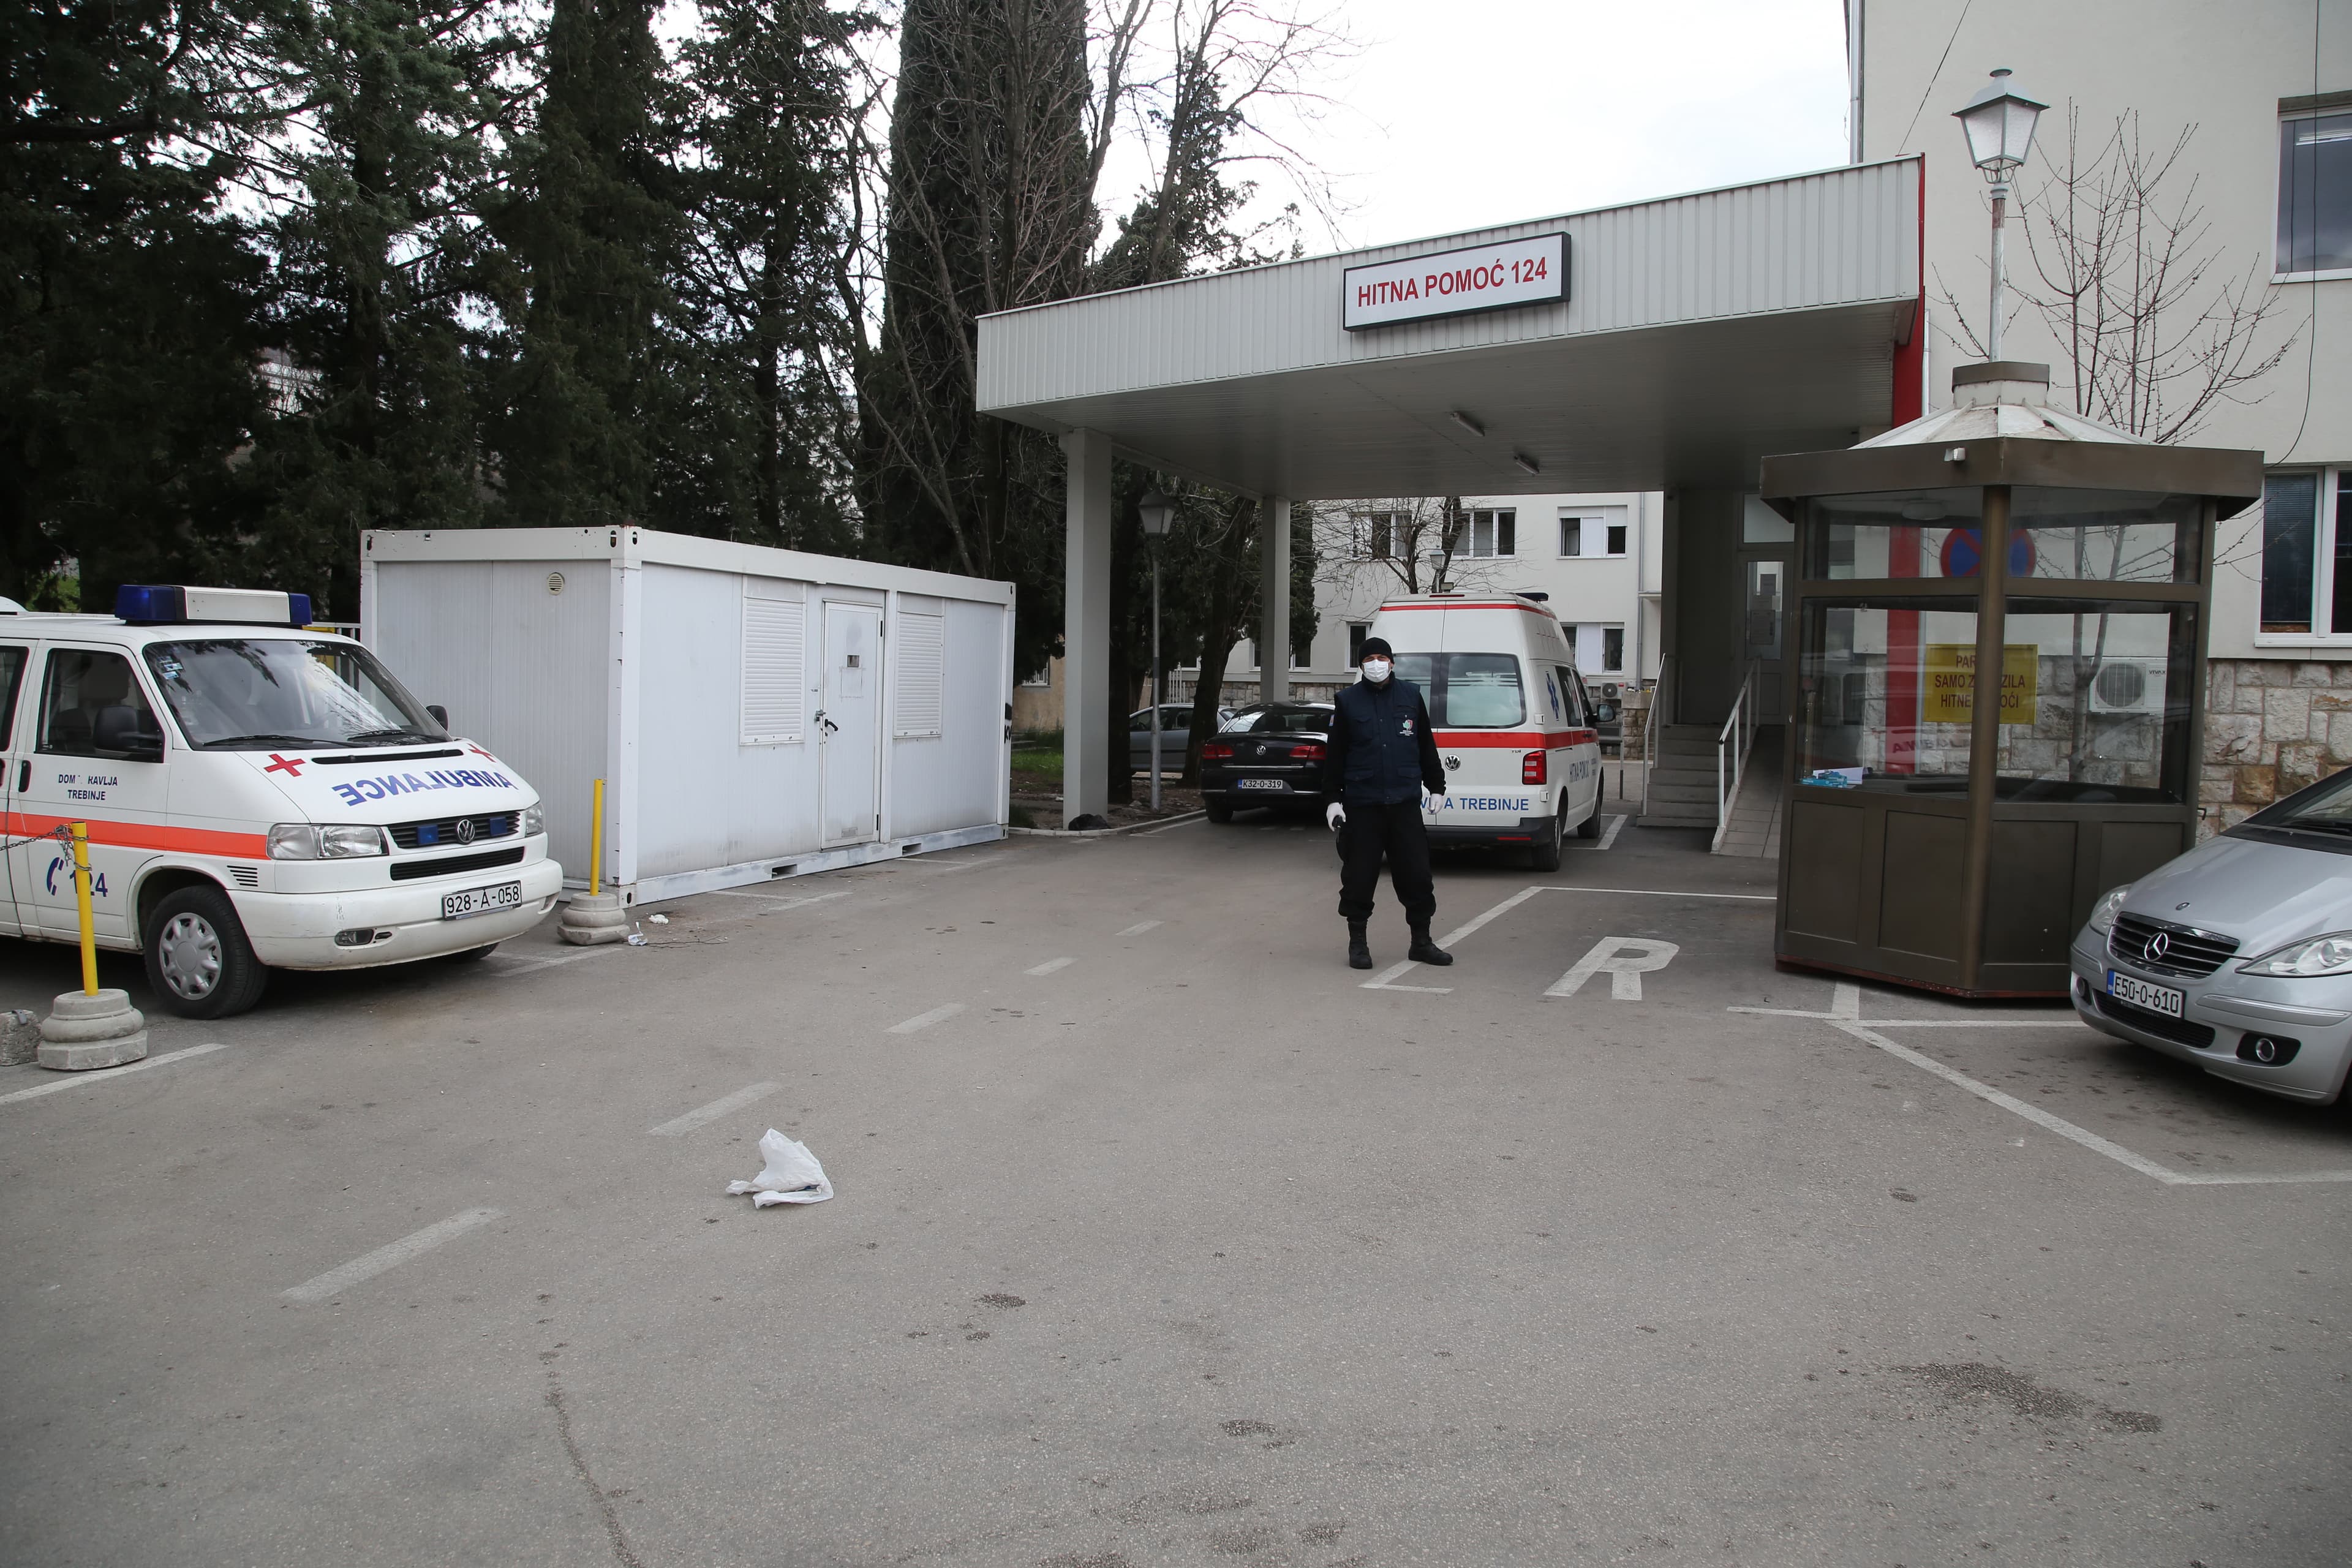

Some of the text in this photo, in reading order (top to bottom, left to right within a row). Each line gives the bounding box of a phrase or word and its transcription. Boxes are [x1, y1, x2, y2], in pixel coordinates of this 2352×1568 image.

[1357, 256, 1548, 307] HITNA POMOĆ 124
[1935, 674, 1965, 688] SAMO
[2000, 674, 2026, 688] ZILA
[1941, 692, 2019, 708] HITNE OĆI
[58, 774, 118, 786] DOM RAVLJA
[67, 790, 106, 801] TREBINJE
[1460, 797, 1529, 811] TREBINJE
[446, 886, 520, 914] 928-A-058
[1542, 936, 1680, 1000] R
